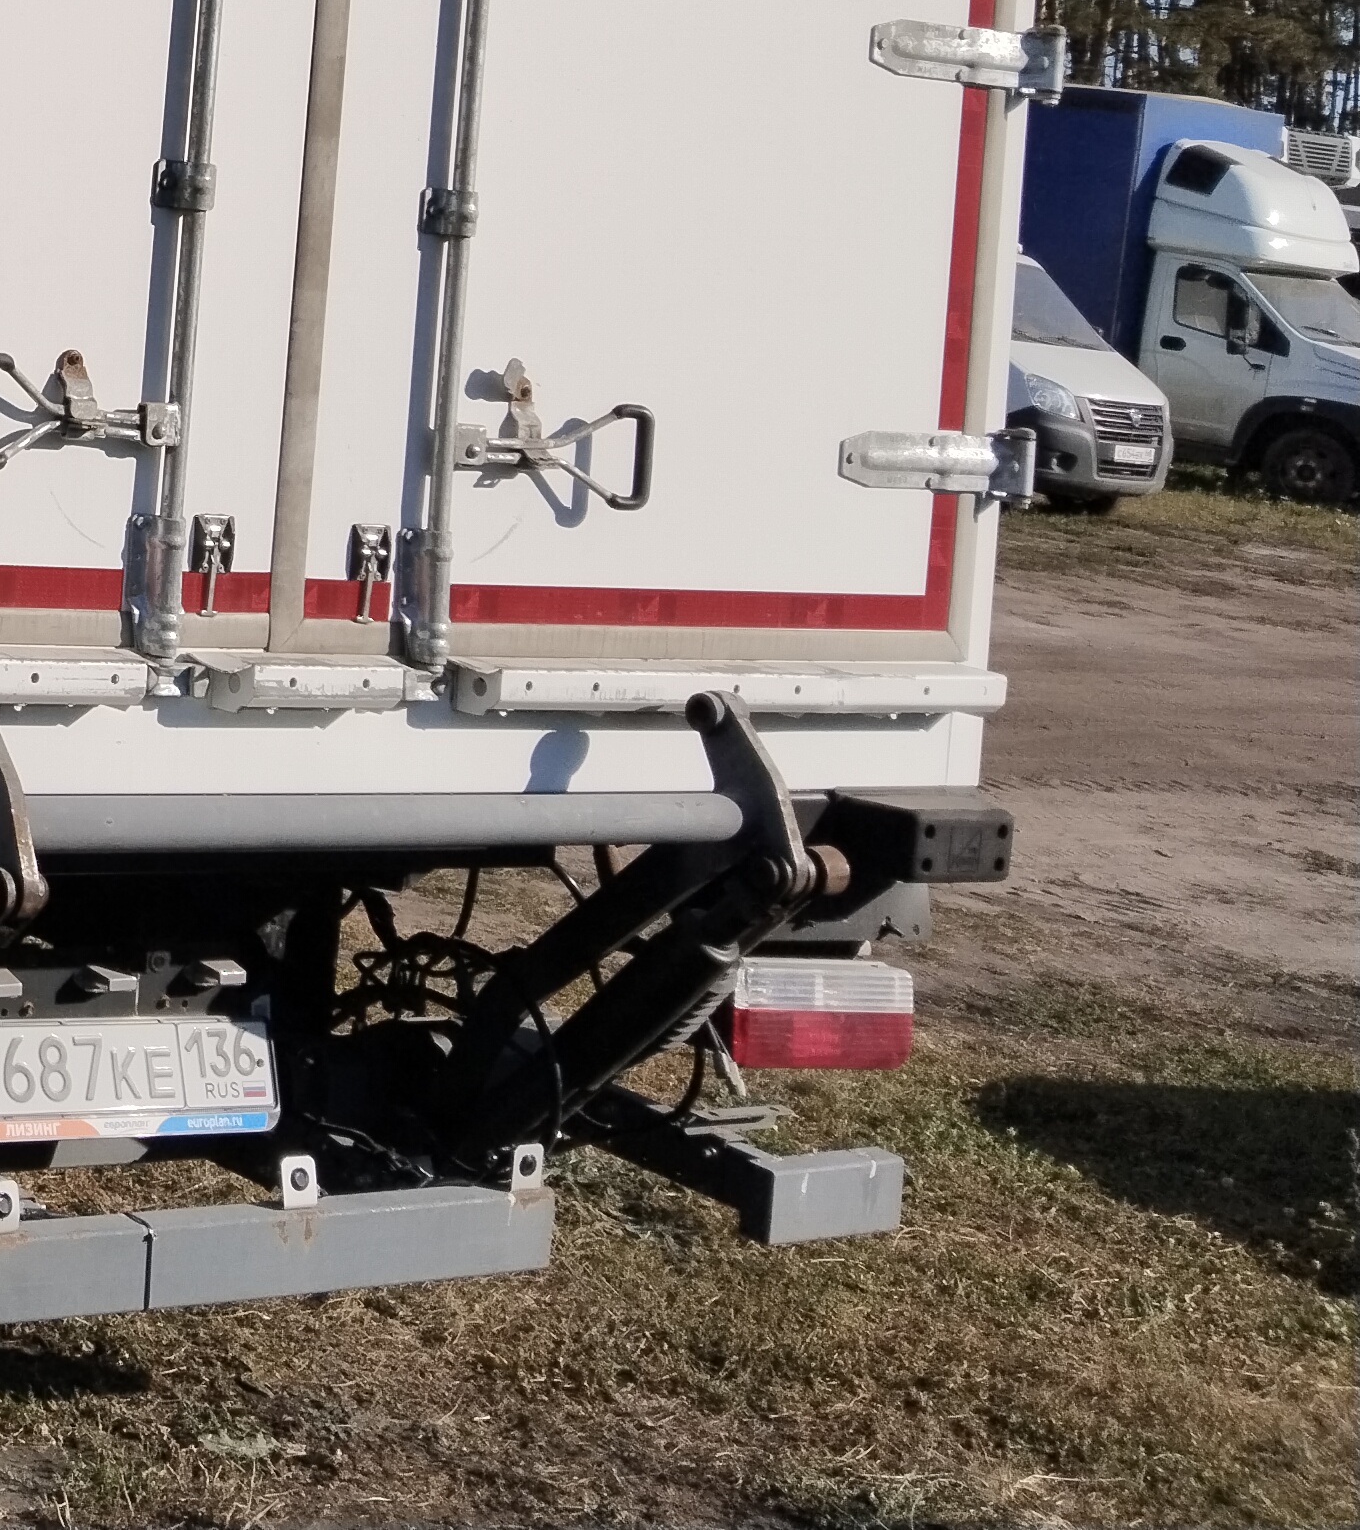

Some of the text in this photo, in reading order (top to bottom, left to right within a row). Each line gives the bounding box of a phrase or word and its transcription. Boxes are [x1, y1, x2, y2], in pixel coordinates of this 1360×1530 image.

[184, 1026, 257, 1079] 136
[204, 1081, 241, 1099] RUS
[4, 1121, 61, 1138] ЛИЗИНГ
[186, 1115, 244, 1131] europlan.ru
